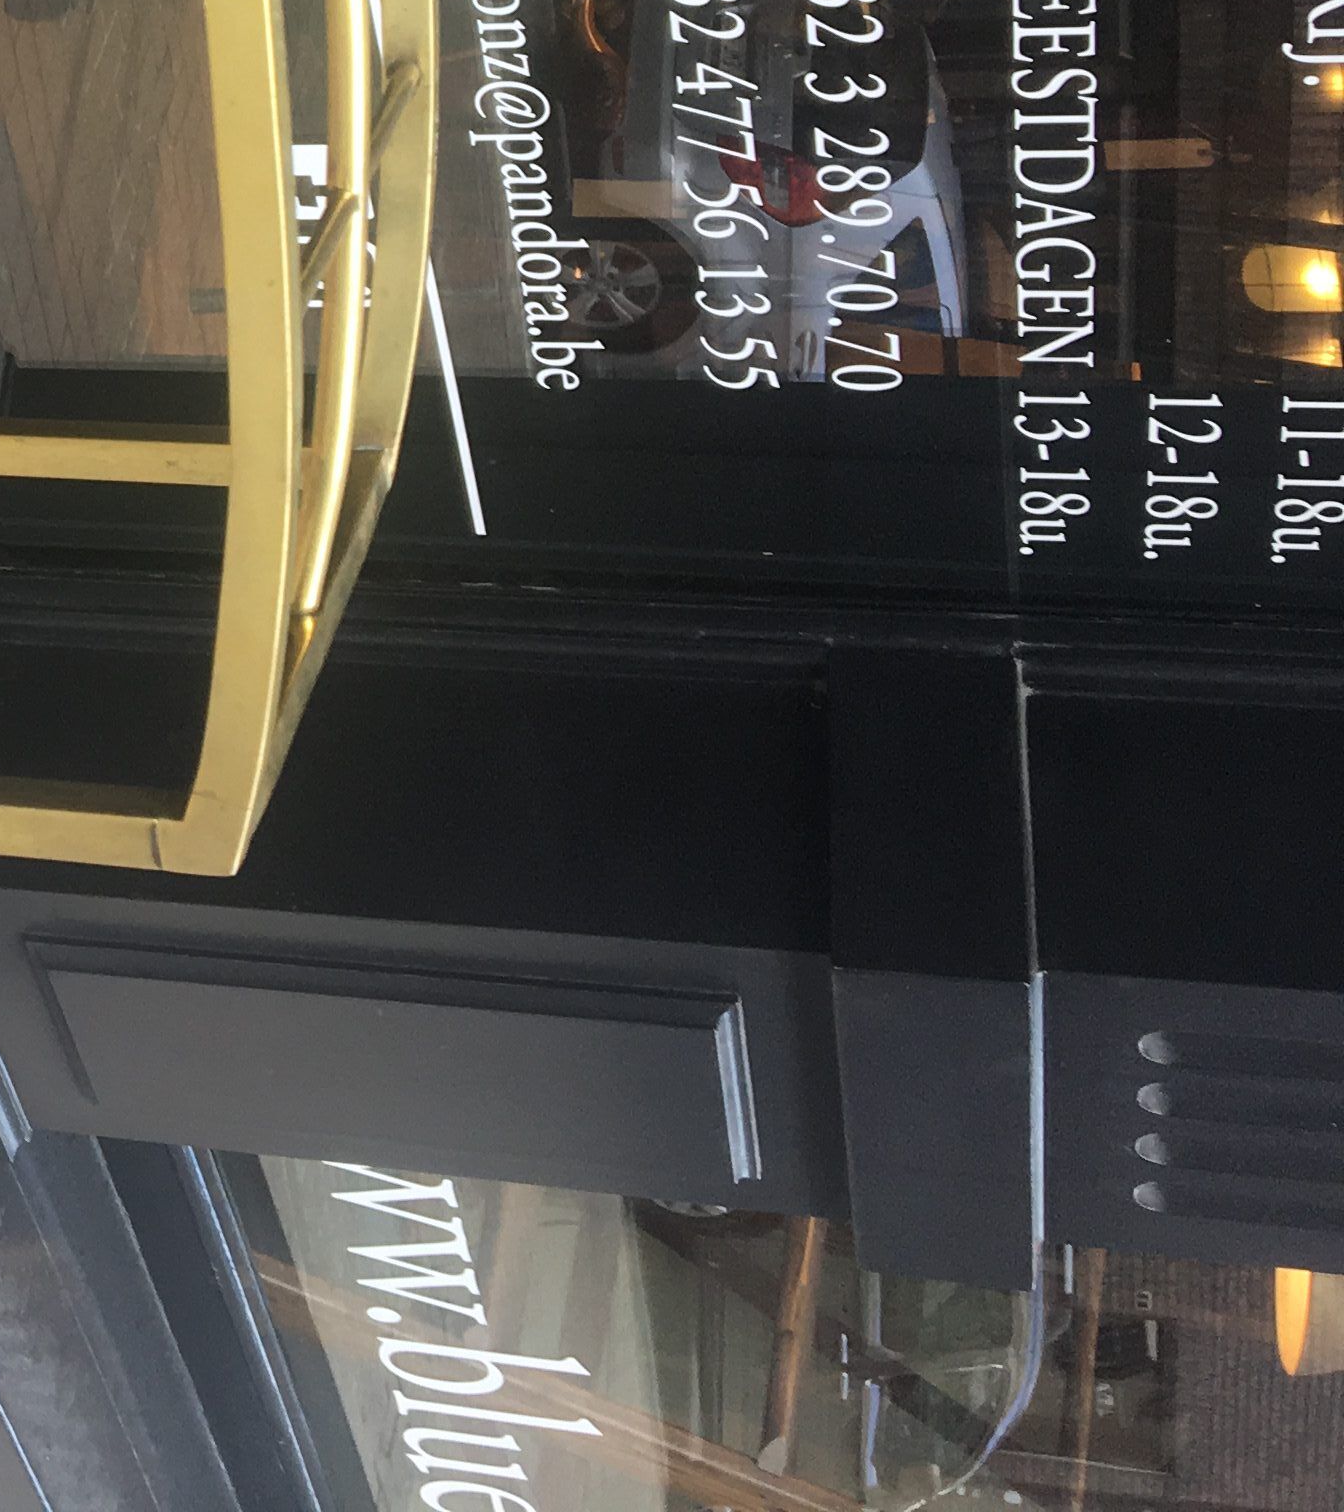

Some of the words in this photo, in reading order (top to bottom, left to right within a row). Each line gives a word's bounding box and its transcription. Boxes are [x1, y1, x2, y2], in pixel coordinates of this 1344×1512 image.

[671, 61, 759, 163] 477
[803, 71, 888, 104] 3
[681, 180, 770, 242] 56
[812, 126, 904, 392] 289.70.70
[693, 263, 773, 319] 13
[698, 335, 782, 391] 55
[1012, 390, 1092, 556] 13-18u.
[1142, 392, 1225, 560] 12-18u.
[1269, 394, 1344, 565] 11-18u.
